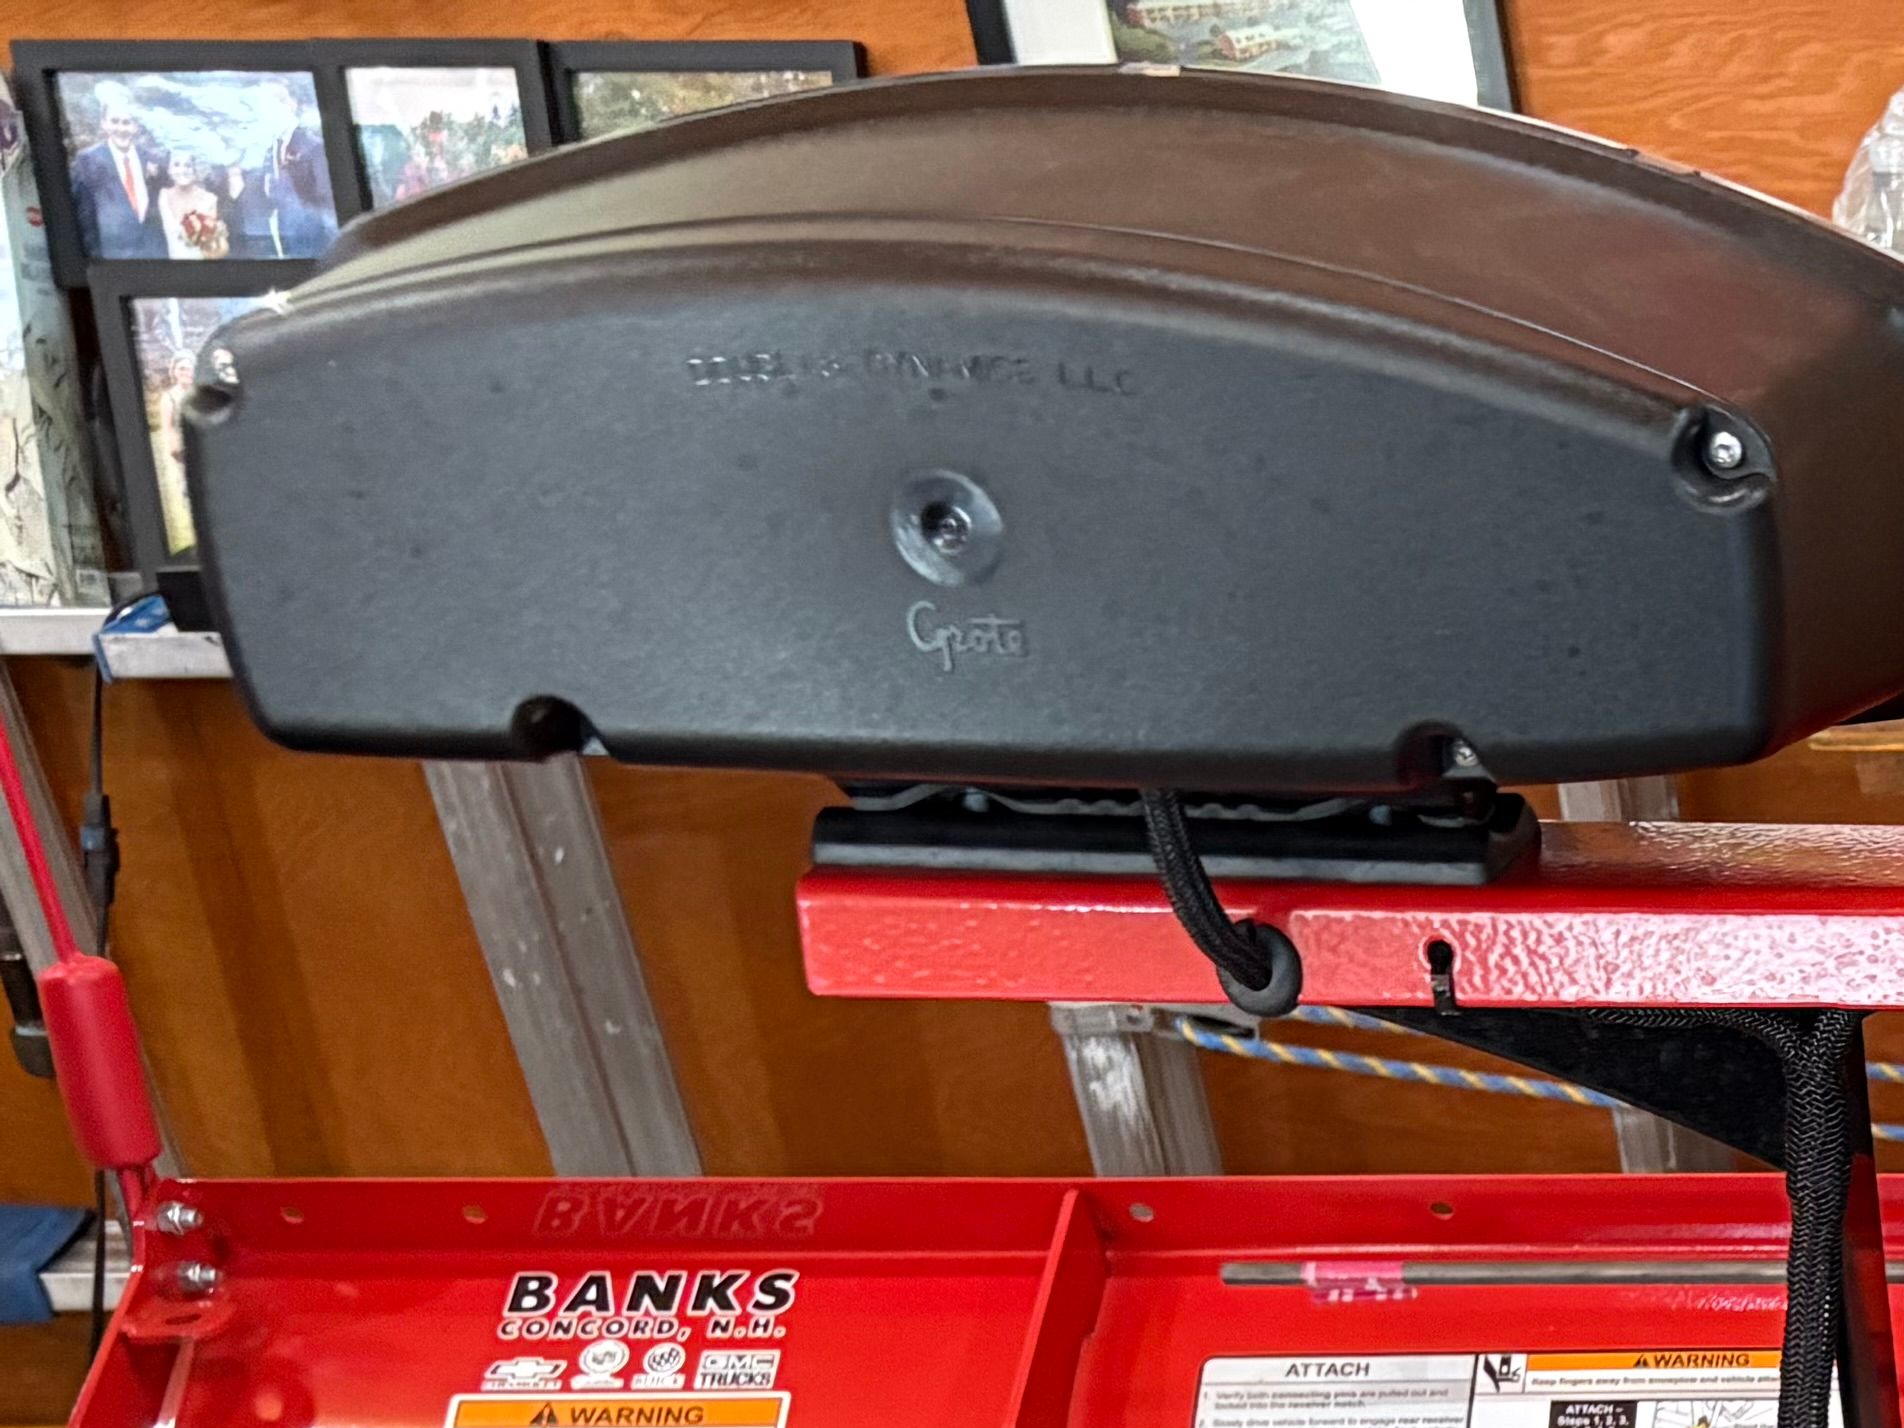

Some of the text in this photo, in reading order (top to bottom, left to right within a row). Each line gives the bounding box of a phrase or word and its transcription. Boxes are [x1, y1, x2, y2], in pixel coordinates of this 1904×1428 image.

[503, 1270, 799, 1316] BANKS
[497, 1316, 786, 1342] CONCORD, N.H.
[1654, 1354, 1750, 1368] WARNING
[1285, 1362, 1369, 1378] ATTACH
[699, 1371, 771, 1387] TRUCKS
[570, 1406, 704, 1425] WARNING
[1566, 1404, 1614, 1414] ATTACH
